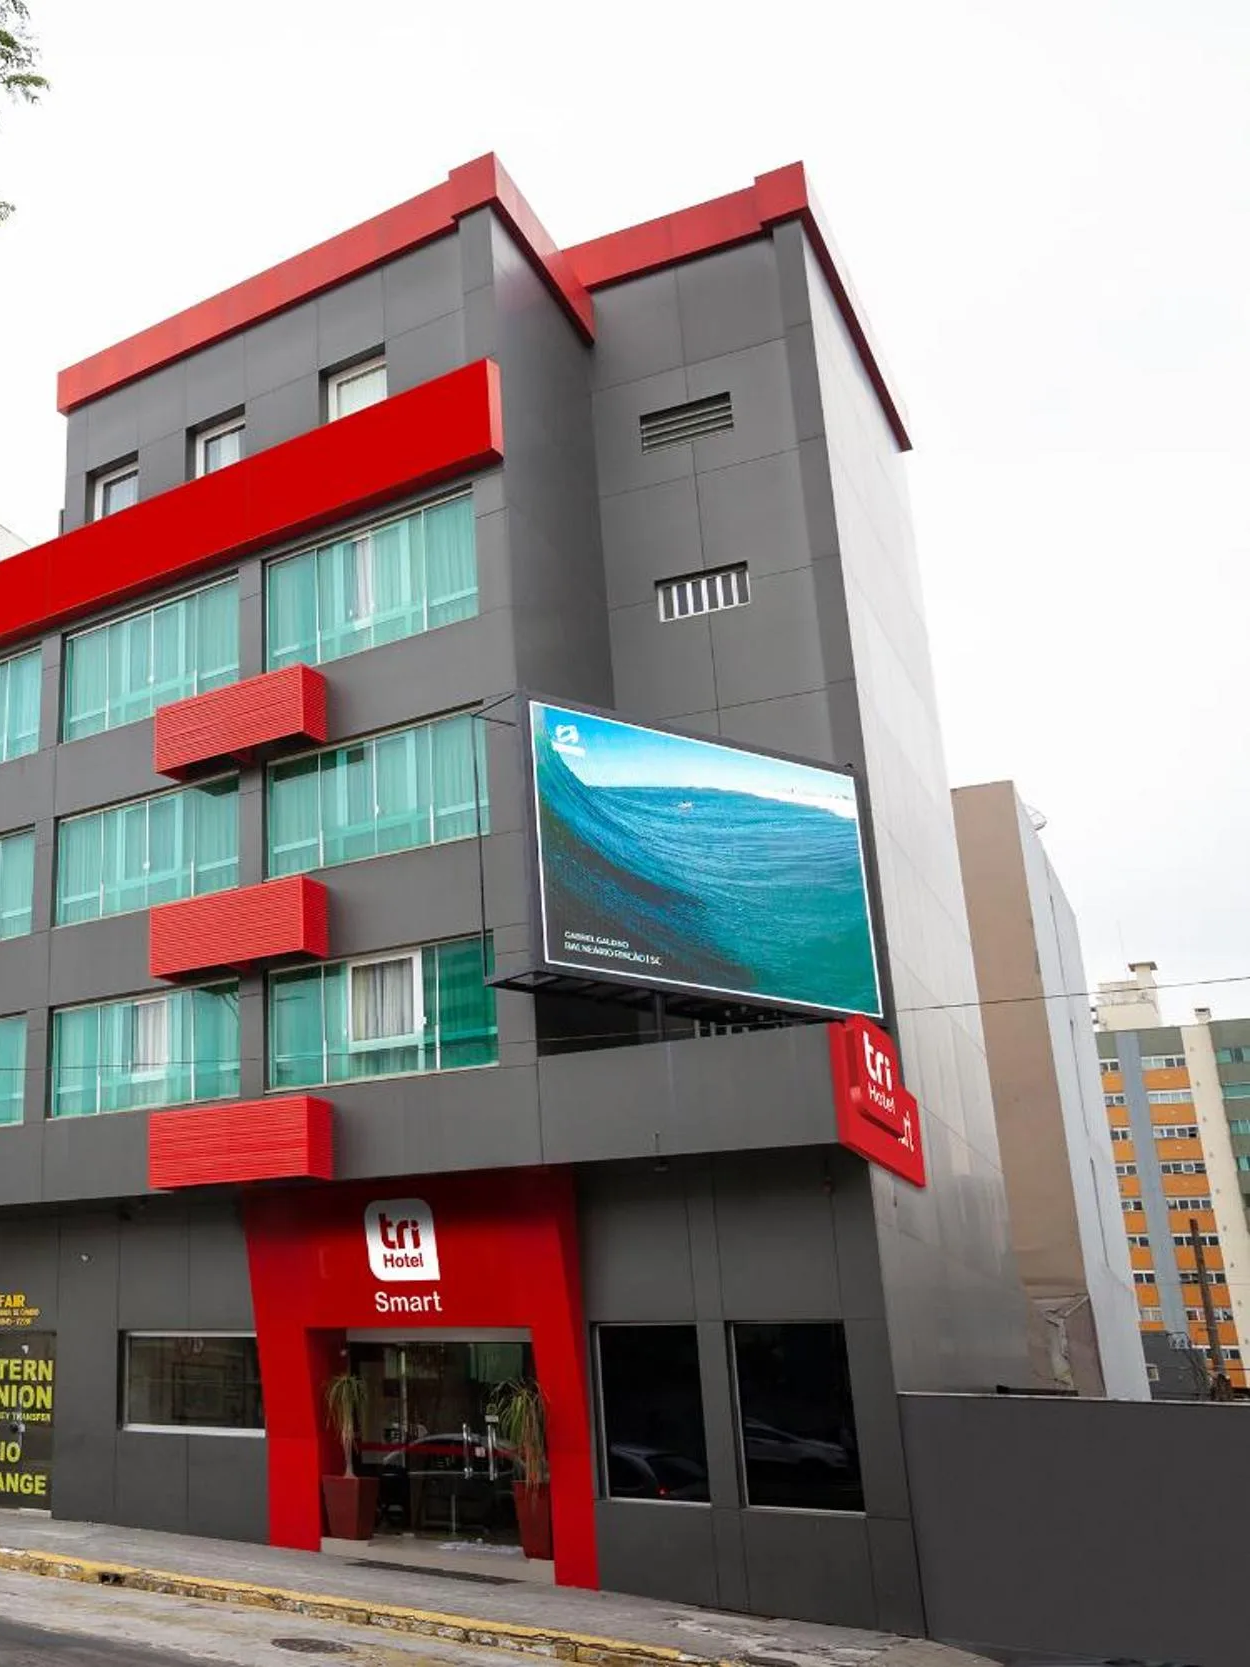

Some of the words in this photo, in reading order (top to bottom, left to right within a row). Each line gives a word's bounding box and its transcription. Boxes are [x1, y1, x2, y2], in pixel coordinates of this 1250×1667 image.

[862, 1030, 893, 1092] tri
[868, 1082, 896, 1115] Hotel
[378, 1212, 421, 1249] tri
[383, 1252, 424, 1269] Hotel
[374, 1290, 443, 1313] Smart
[12, 1411, 51, 1422] TRANSFER
